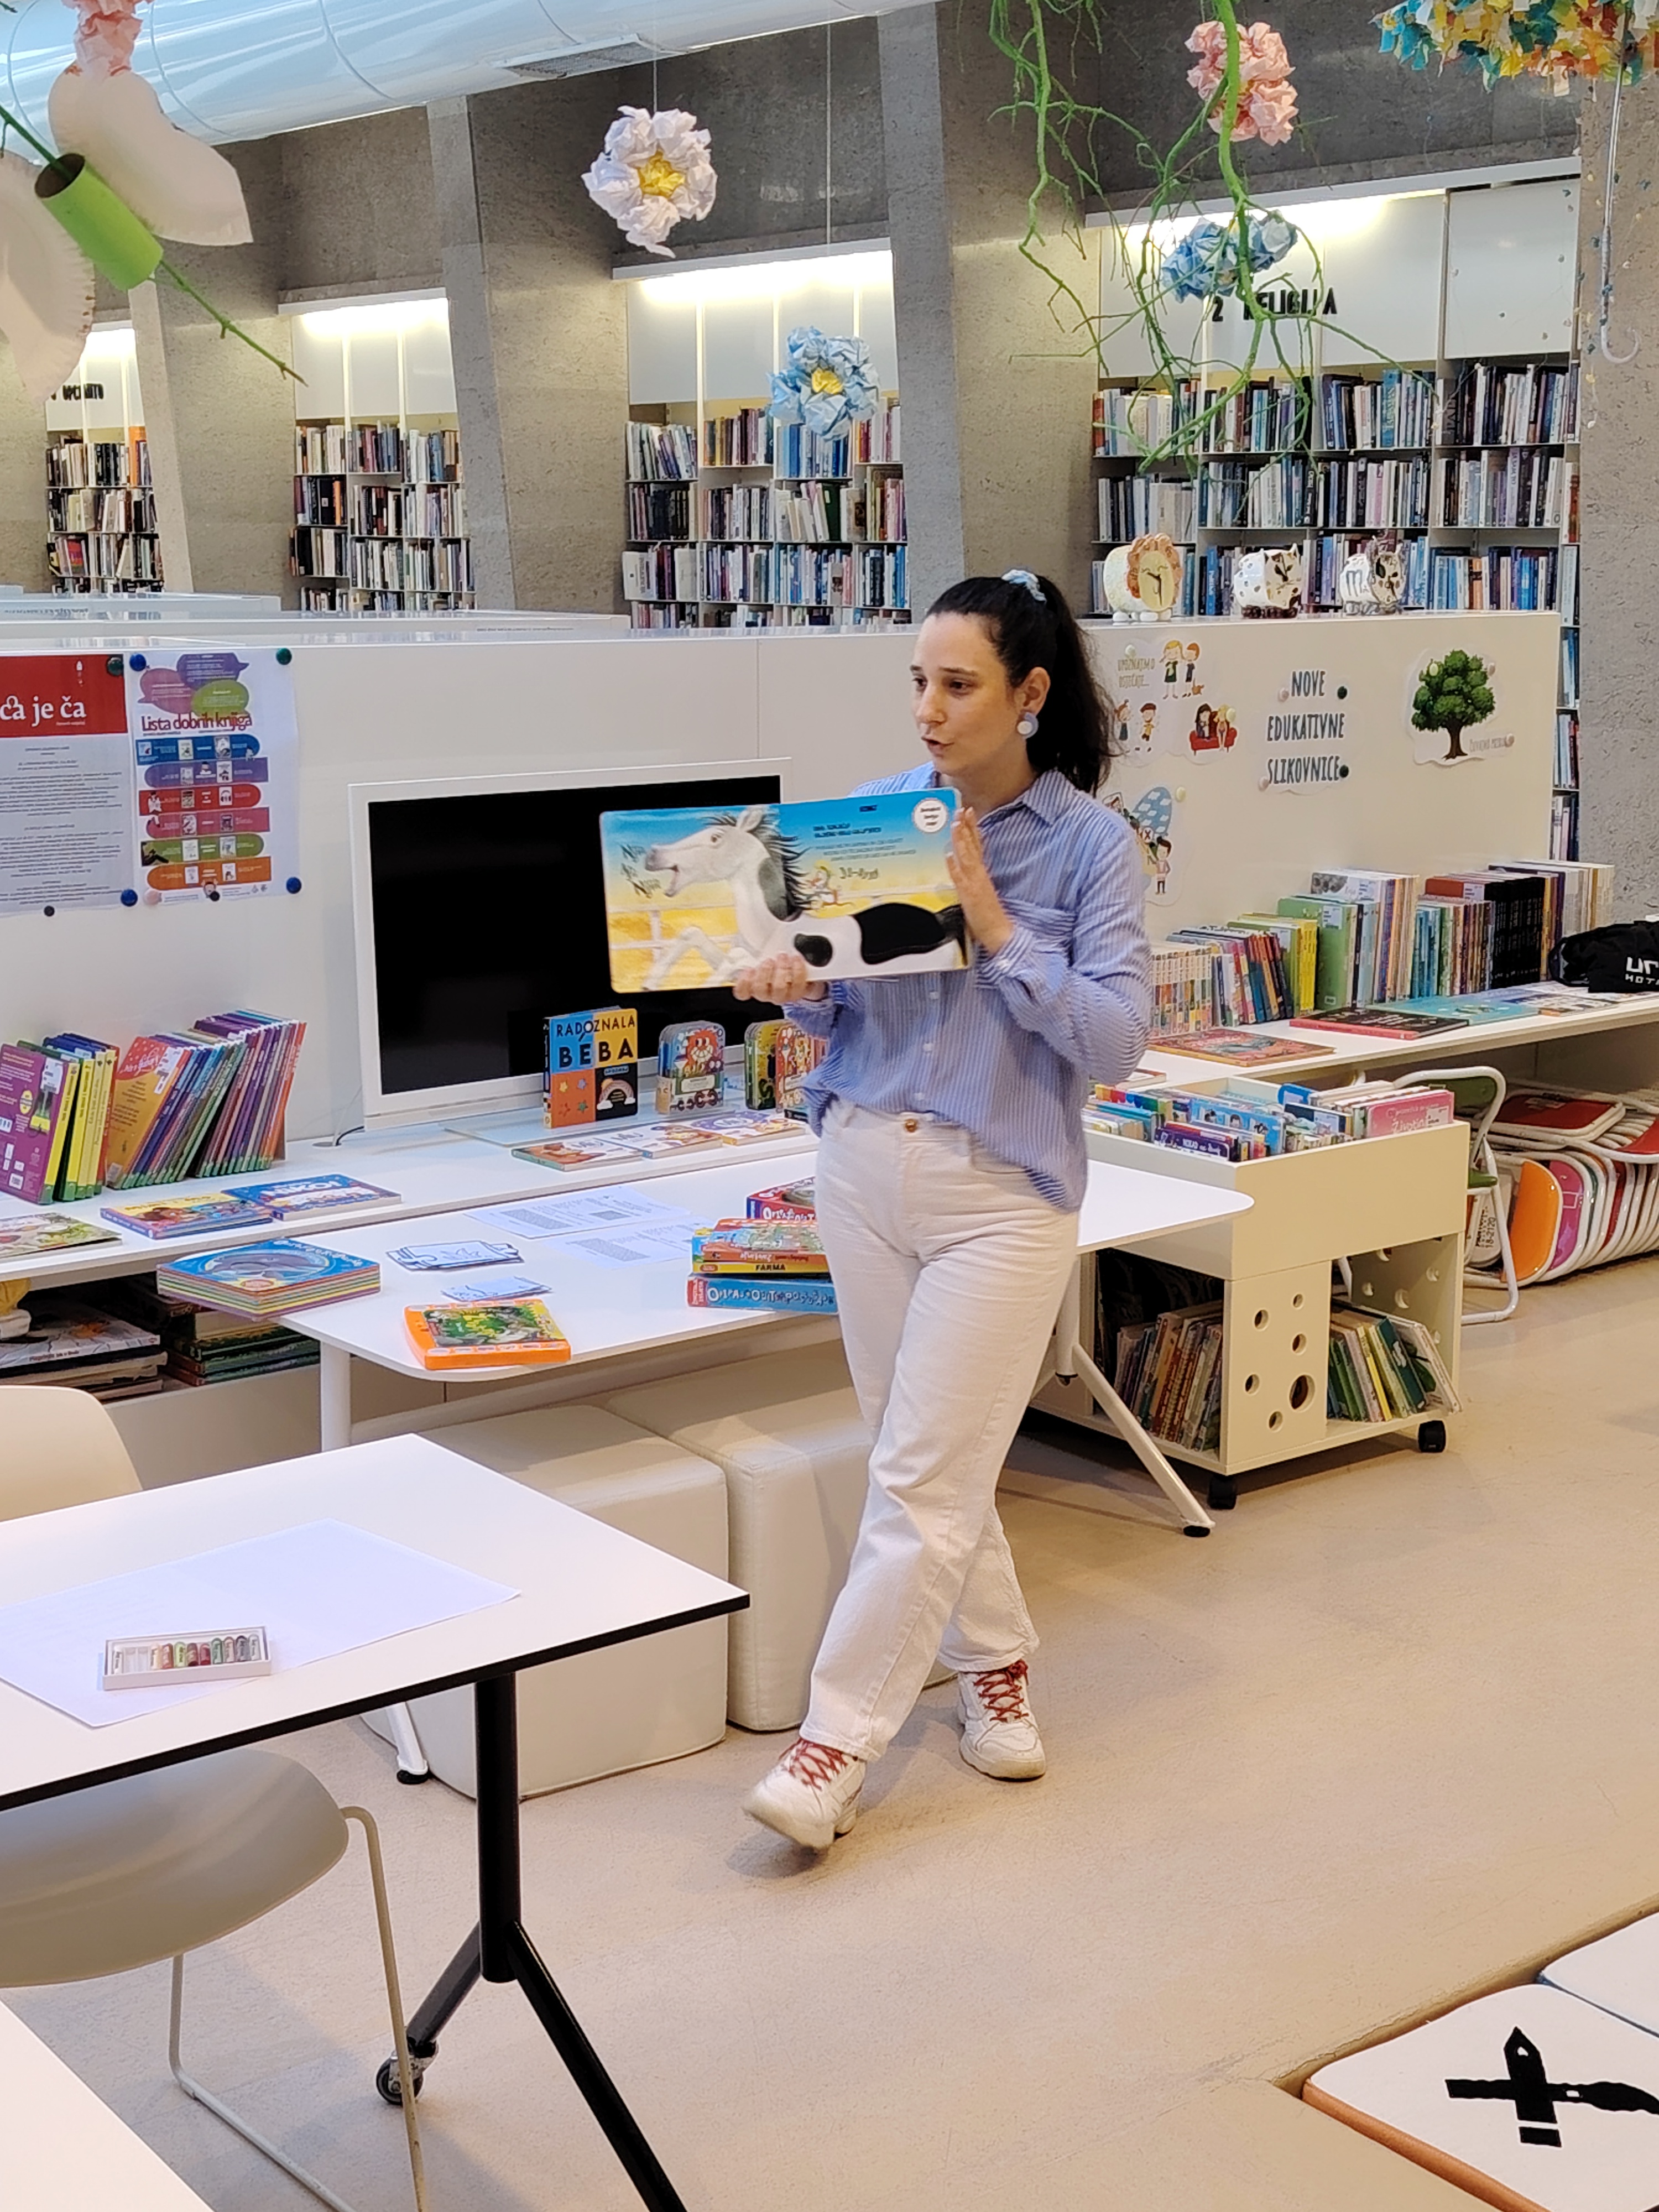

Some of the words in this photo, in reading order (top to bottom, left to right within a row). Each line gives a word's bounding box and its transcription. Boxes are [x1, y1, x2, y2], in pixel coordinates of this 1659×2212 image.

[1212, 296, 1224, 322] 2
[1291, 670, 1326, 697] NOVE
[32, 696, 54, 727] je
[60, 695, 87, 718] ča
[141, 716, 171, 732] Lista
[173, 712, 214, 731] dobrih
[216, 711, 253, 731] knjiga
[1267, 713, 1345, 742] EDUKATIVNE
[1267, 755, 1340, 784] SLIKOVNICE
[556, 1015, 635, 1037] RADOZNALA
[559, 1038, 633, 1068] BEBA
[755, 1263, 786, 1271] FARMA
